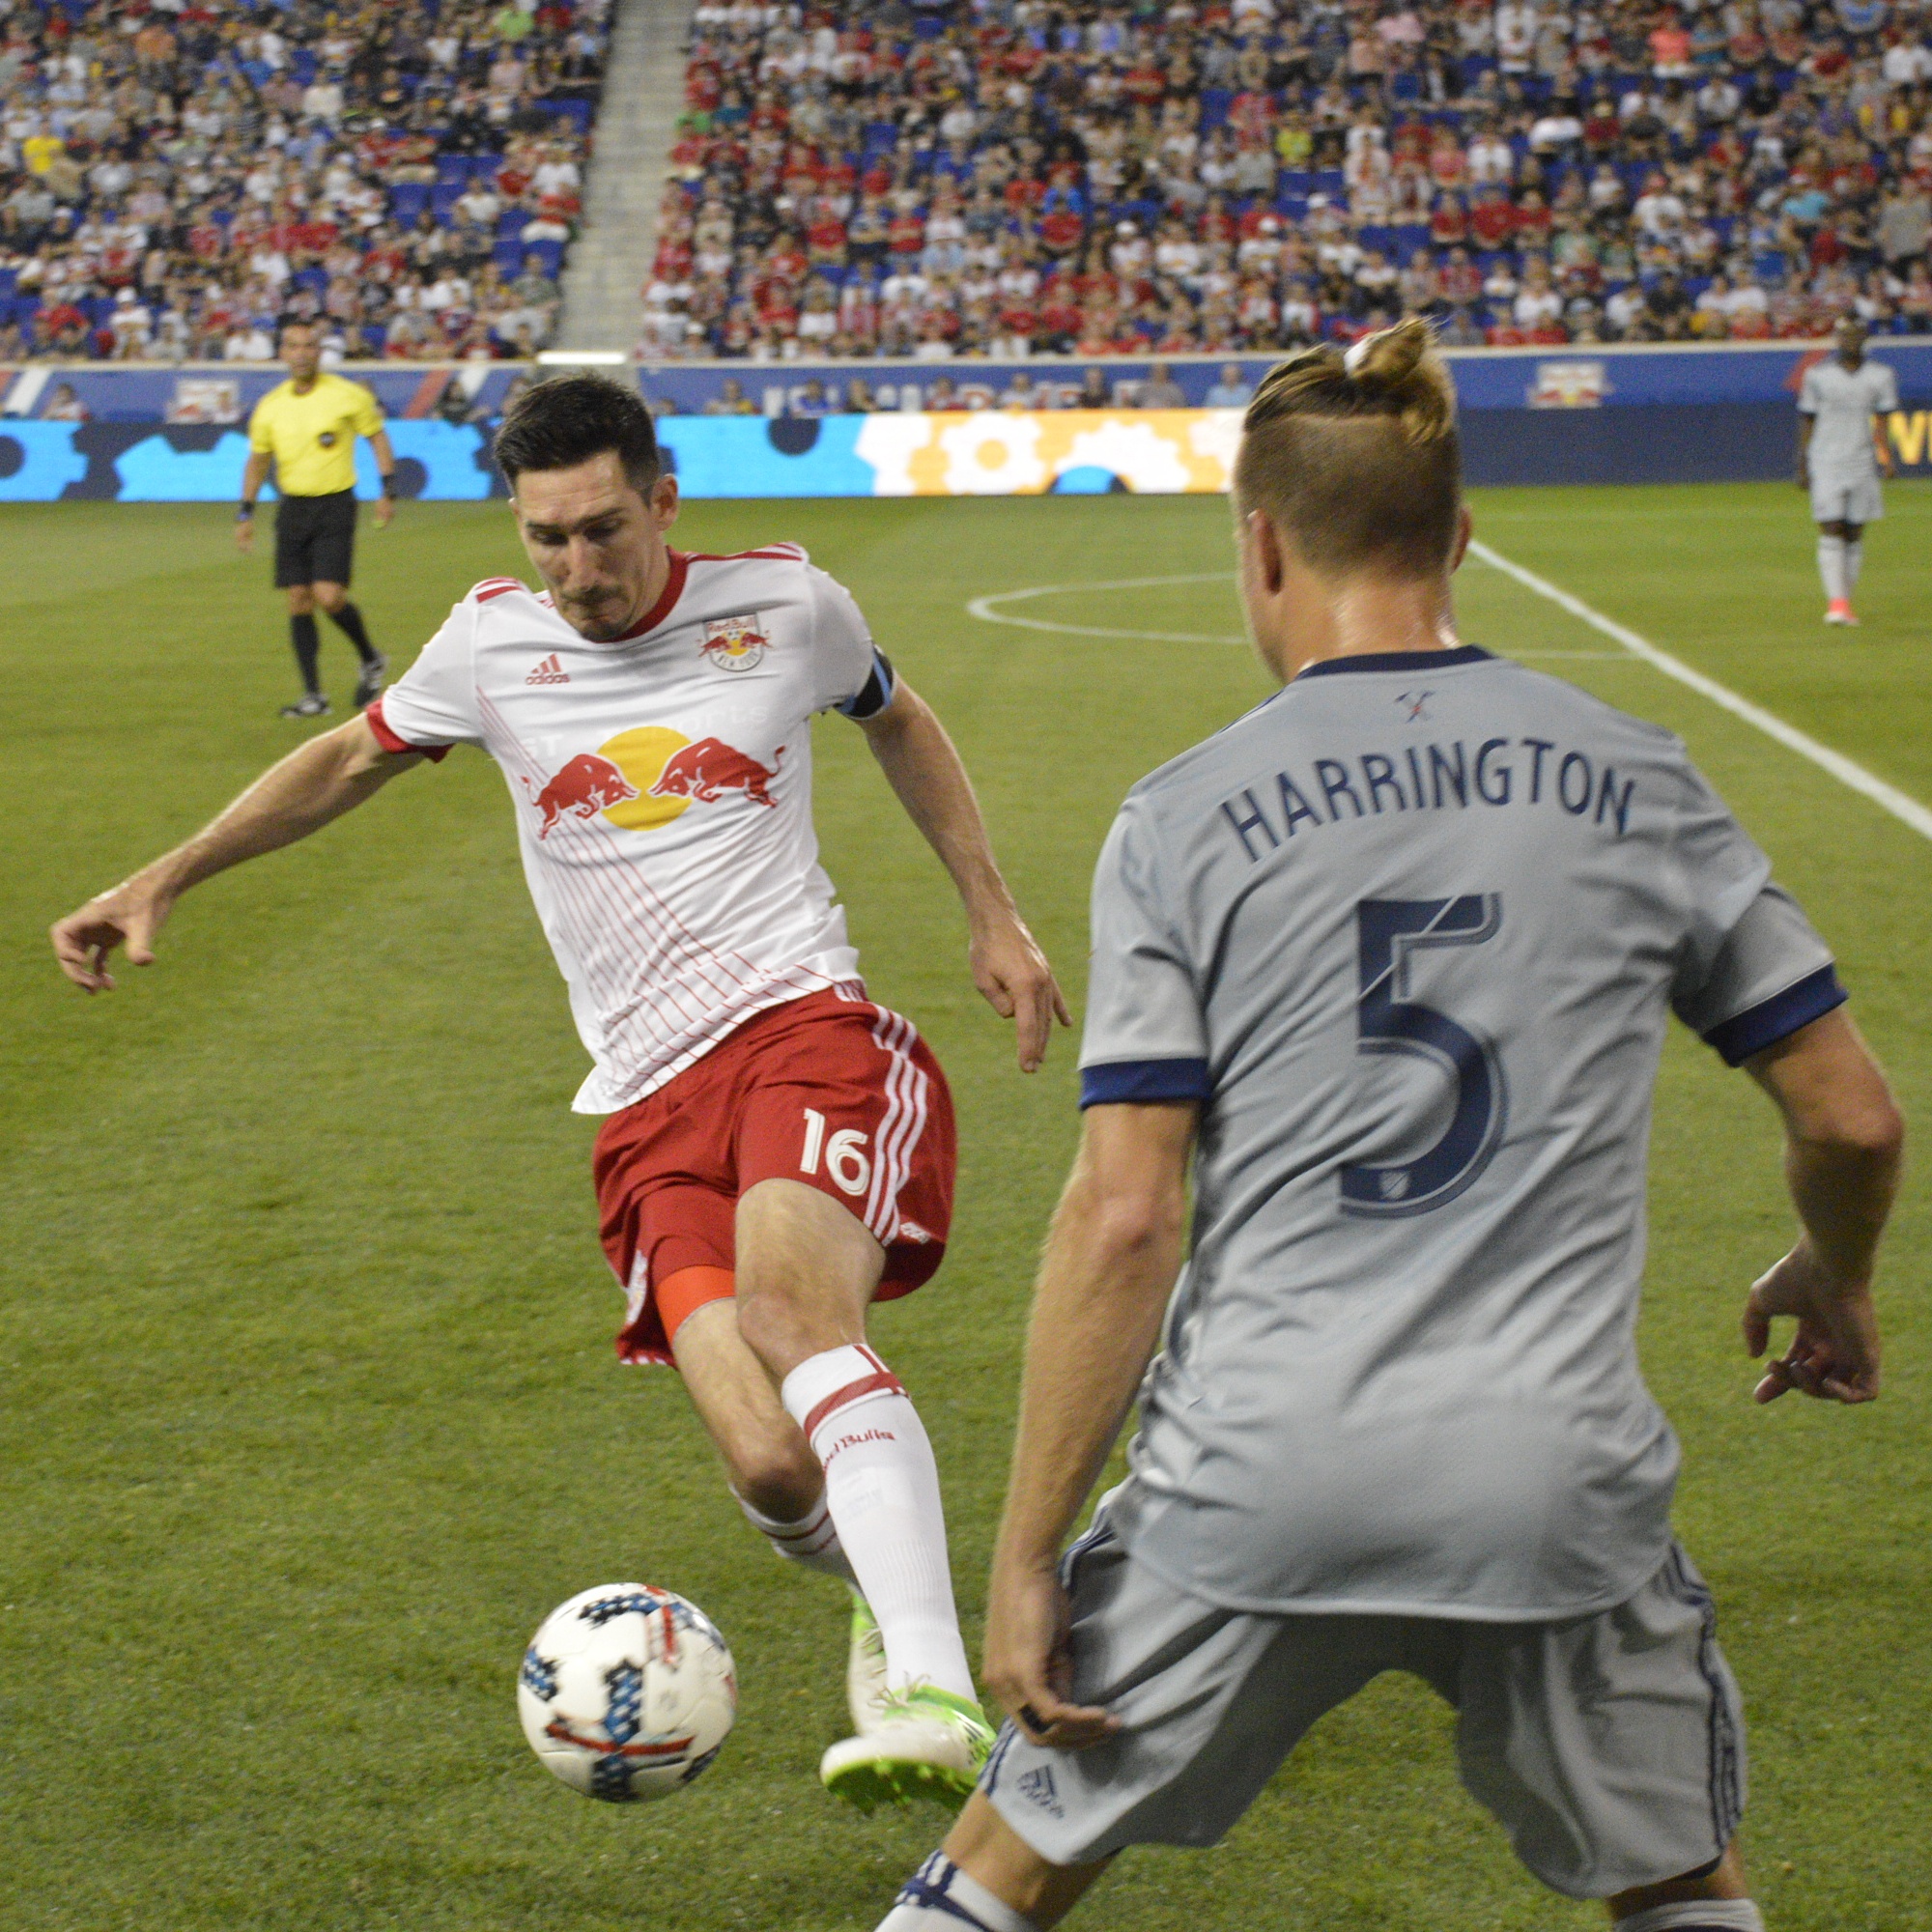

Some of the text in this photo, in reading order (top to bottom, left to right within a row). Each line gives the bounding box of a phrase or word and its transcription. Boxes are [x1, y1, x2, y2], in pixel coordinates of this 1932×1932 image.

[525, 671, 571, 686] adidas
[1222, 738, 1636, 863] HARRINGTON
[1340, 892, 1511, 1219] 5
[800, 1107, 870, 1197] 16
[839, 1429, 895, 1448] Bulls
